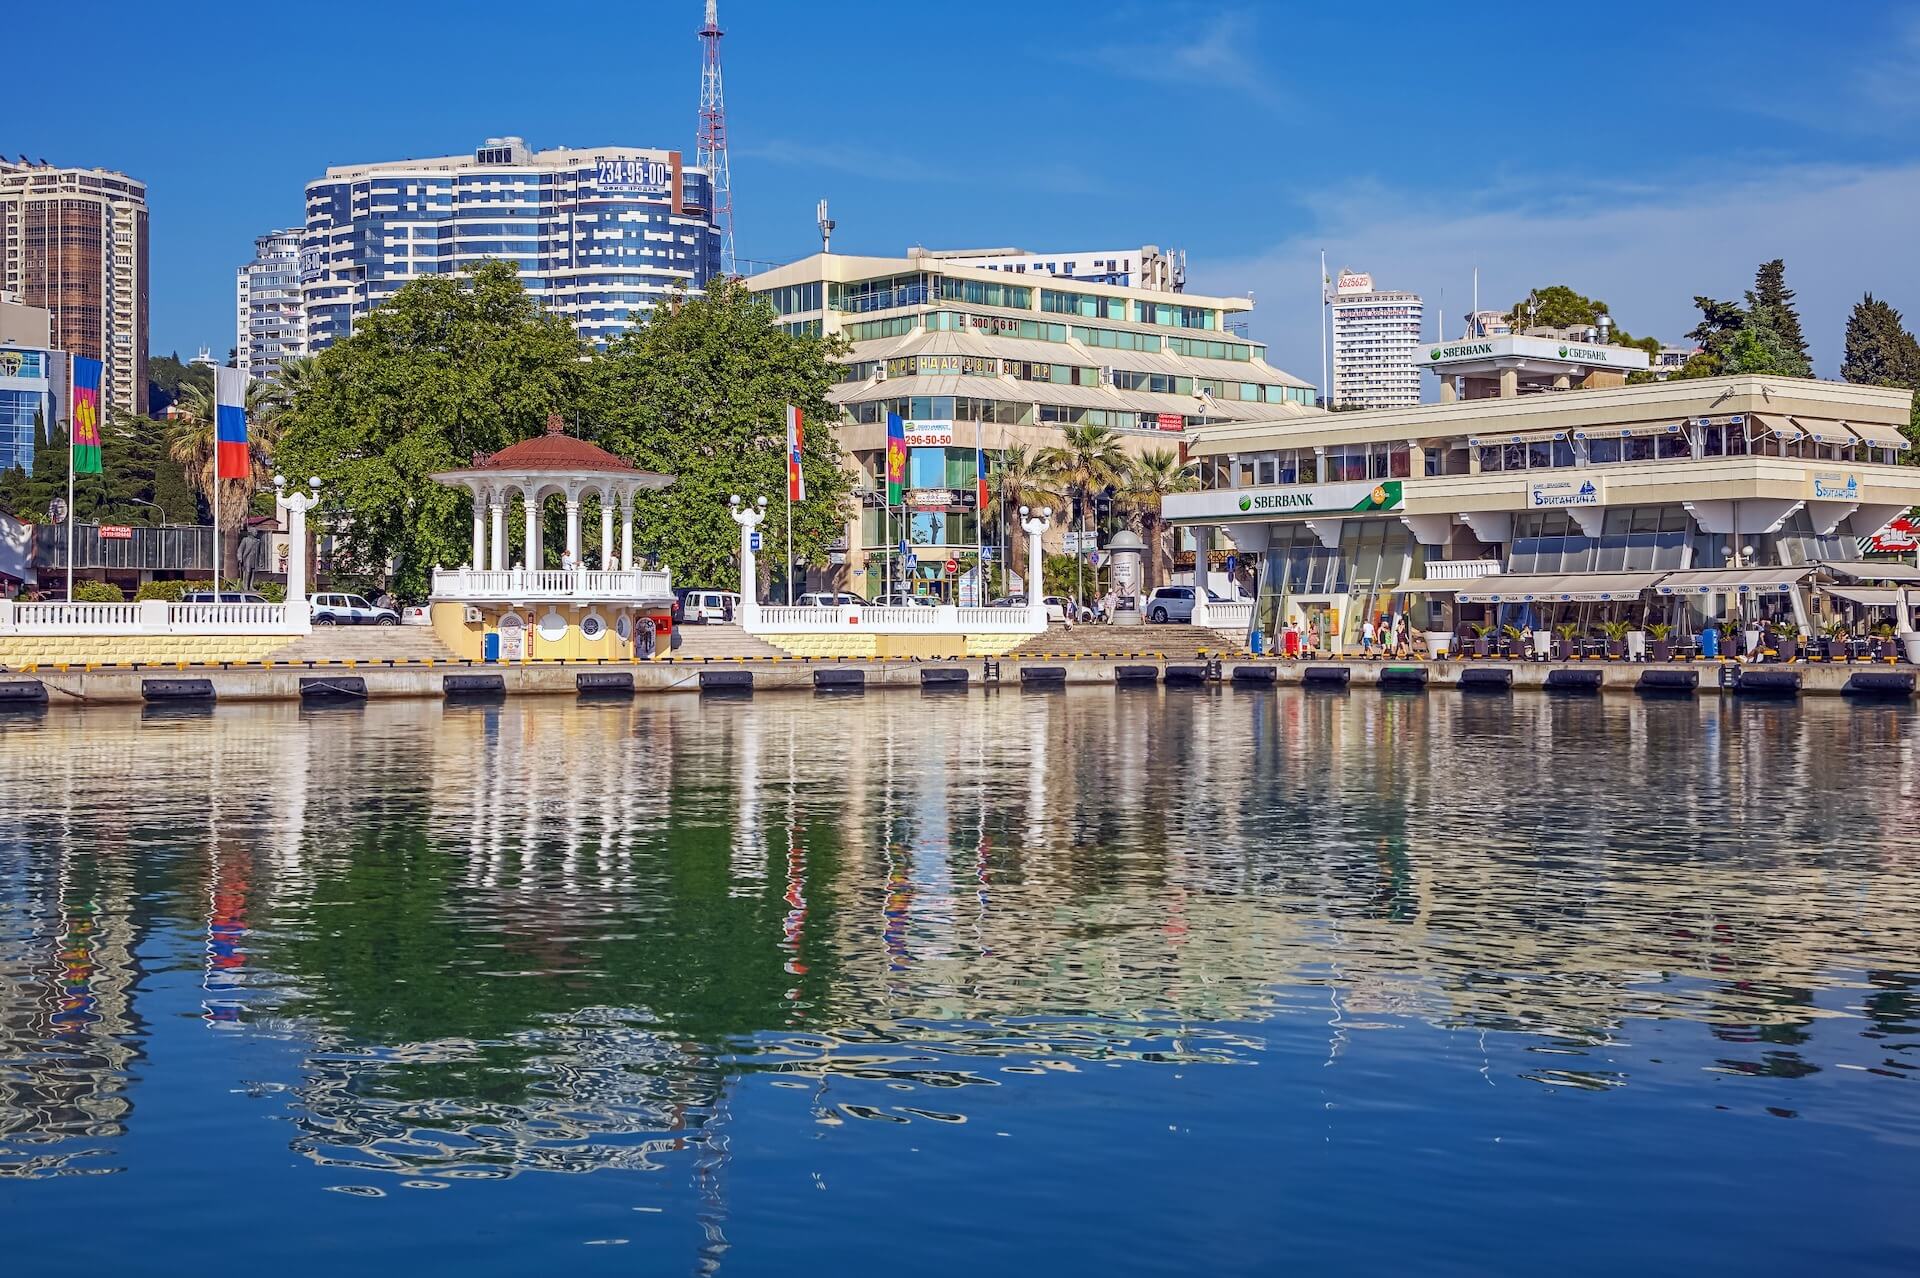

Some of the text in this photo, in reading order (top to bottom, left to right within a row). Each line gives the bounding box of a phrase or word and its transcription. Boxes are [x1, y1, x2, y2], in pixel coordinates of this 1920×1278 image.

[599, 161, 665, 185] 234-95-00
[1338, 277, 1368, 288] 2625625
[972, 317, 988, 328] 300
[1443, 343, 1492, 358] SBERBANK
[1569, 347, 1607, 360] СБЕРБАНК
[905, 435, 951, 444] 296-50-50
[1254, 493, 1314, 509] SBERBANK
